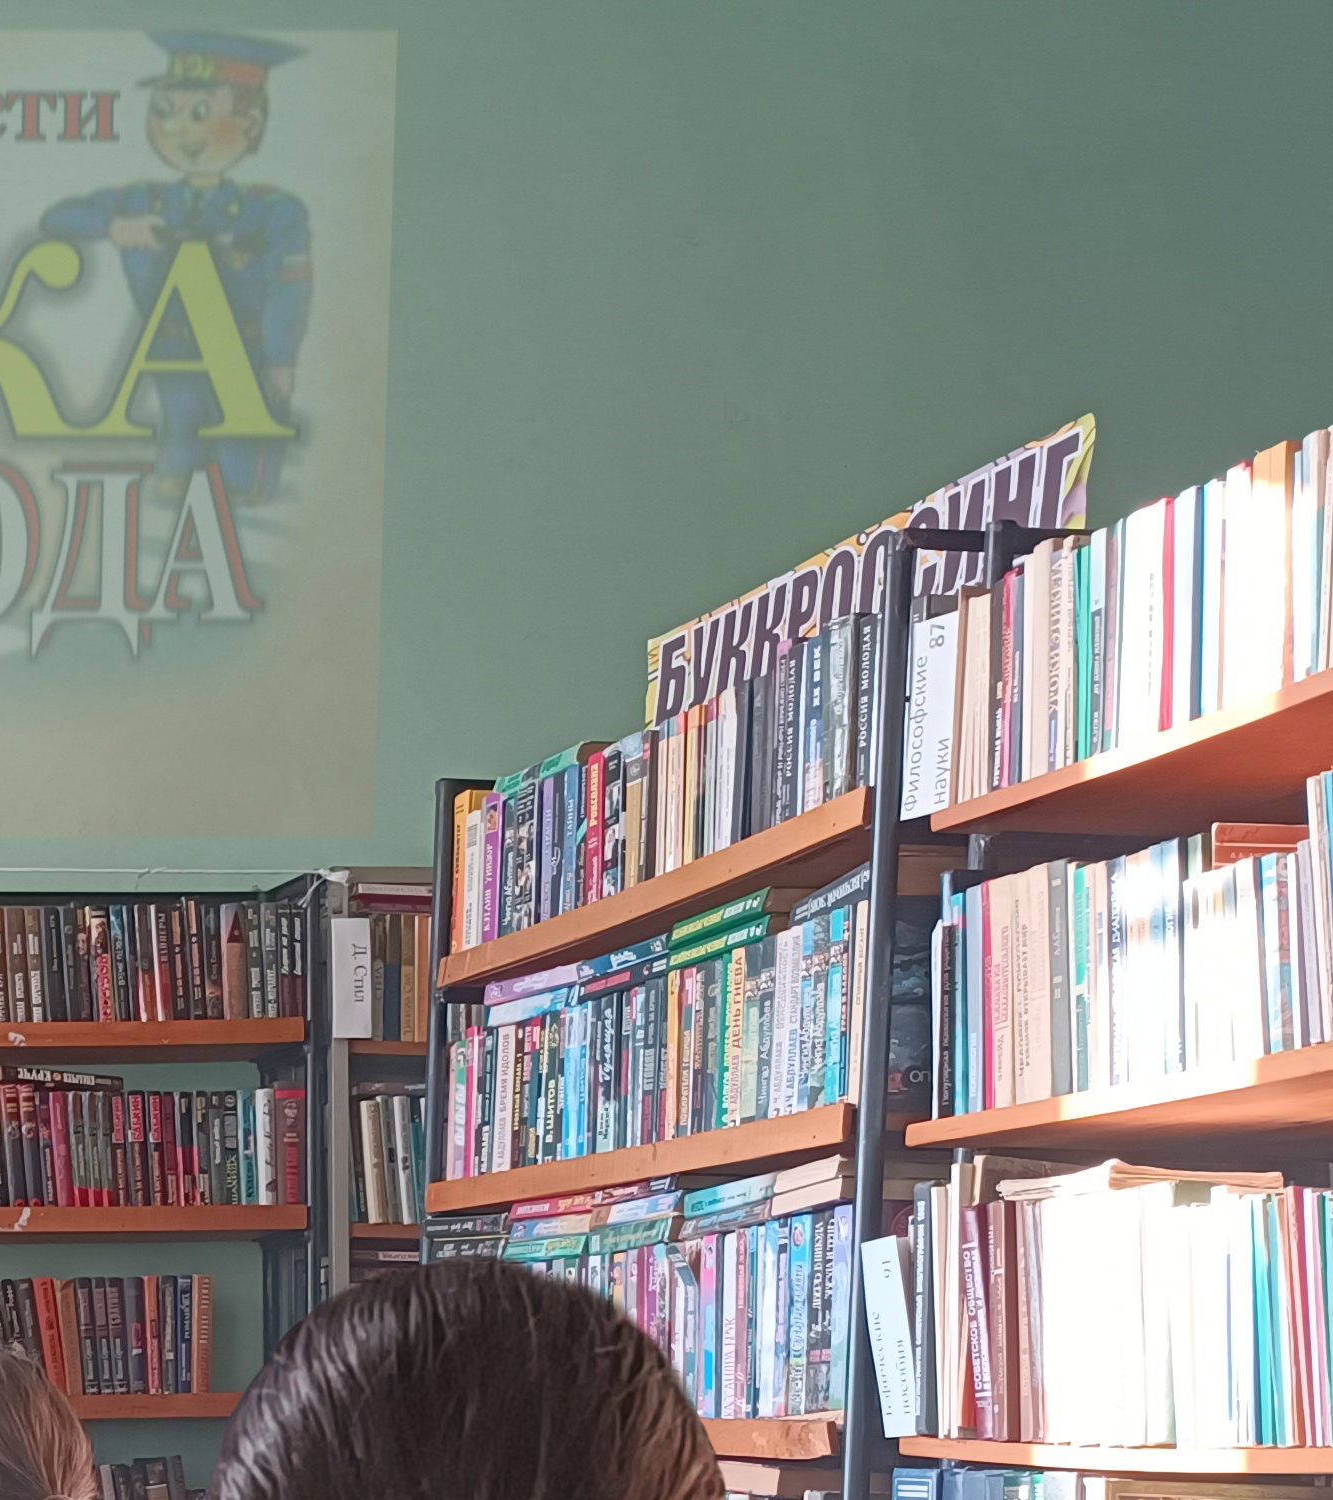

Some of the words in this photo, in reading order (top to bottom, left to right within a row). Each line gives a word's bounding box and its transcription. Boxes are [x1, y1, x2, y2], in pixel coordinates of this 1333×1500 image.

[860, 624, 872, 692] МОЛОДАЯ
[929, 623, 945, 649] 87
[858, 694, 869, 748] РОССИЯ
[904, 655, 928, 812] Философские
[934, 737, 950, 805] Науки
[353, 963, 365, 1003] Стил
[734, 955, 743, 1006] ГНЕВА
[500, 1032, 510, 1080] ИДОЛОВ
[731, 1007, 742, 1049] ДЕНЬ
[760, 999, 771, 1060] Абдуллаев
[729, 1054, 740, 1104] АБДУЛЛАЕВ
[785, 1028, 798, 1090] АБДУЛЛАЕВ
[499, 1085, 507, 1113] БРЕМЯ
[545, 1079, 555, 1143] В.ШИТОВ
[963, 1250, 978, 1316] ОБЩЕСТВО
[894, 1338, 911, 1415] пособия
[968, 1316, 984, 1392] СОВЕТСКОЕ
